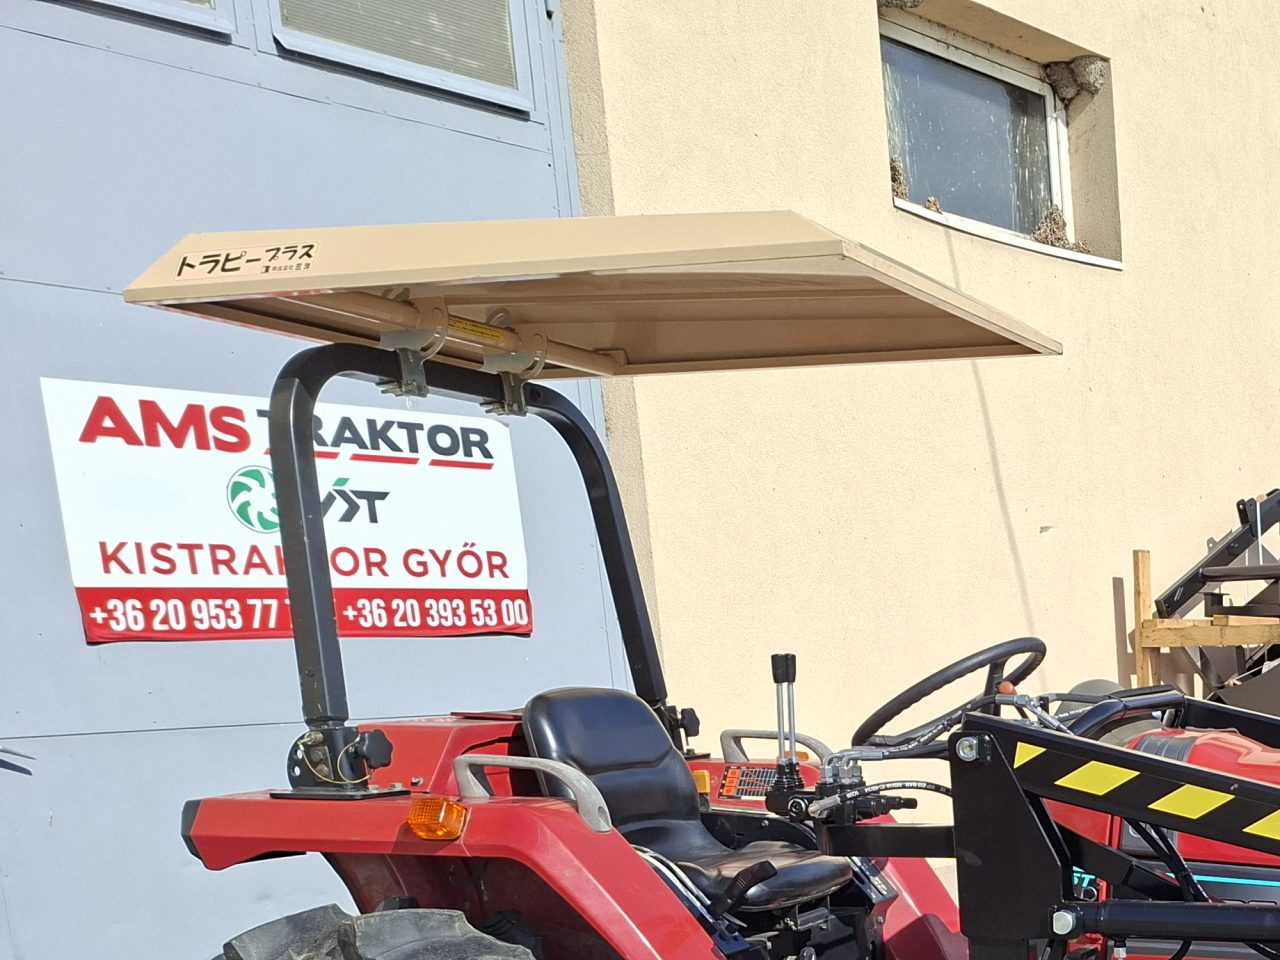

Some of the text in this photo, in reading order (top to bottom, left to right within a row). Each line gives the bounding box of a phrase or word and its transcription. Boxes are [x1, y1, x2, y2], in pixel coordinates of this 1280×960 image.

[78, 395, 495, 460] AMS RAKTOR
[98, 541, 510, 579] KISTRAOR GYŐR
[89, 598, 145, 632] +36
[149, 598, 188, 631] 20
[191, 598, 244, 631] 953
[246, 598, 279, 630] 77
[343, 598, 388, 628] +36
[391, 598, 421, 628] 20
[424, 598, 467, 628] 393
[470, 598, 498, 627] 53
[502, 598, 529, 626] 00
